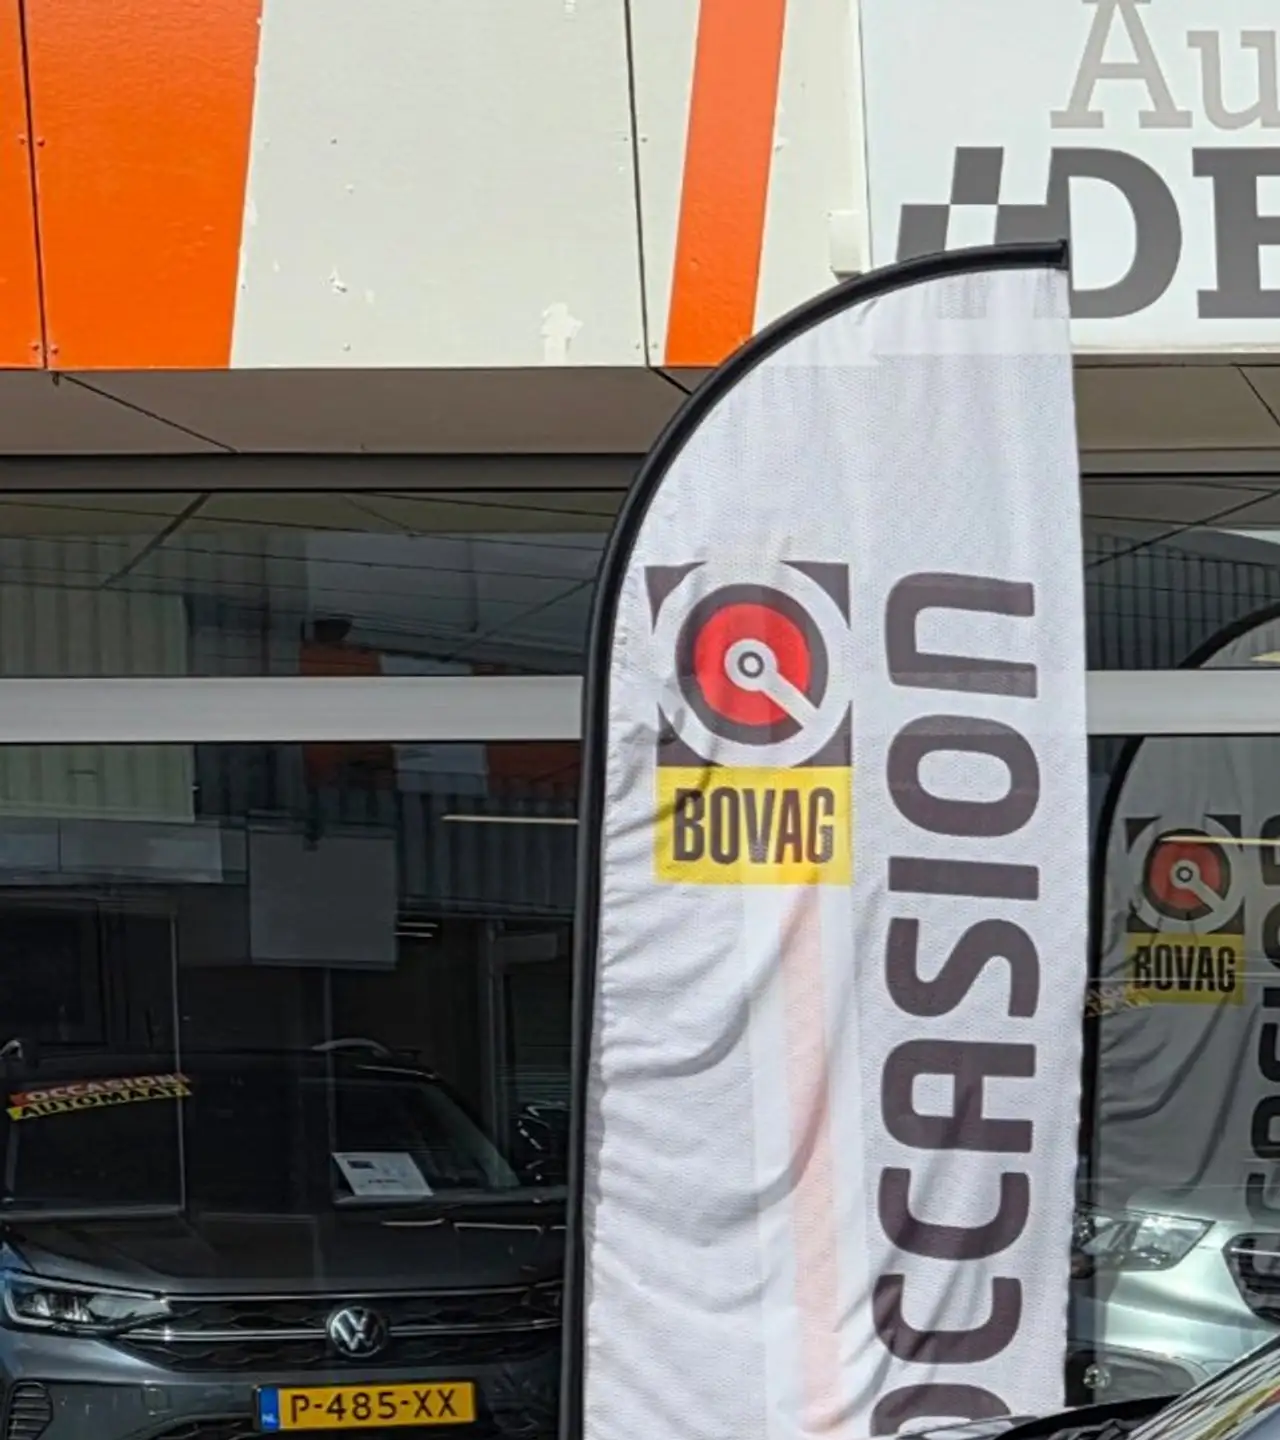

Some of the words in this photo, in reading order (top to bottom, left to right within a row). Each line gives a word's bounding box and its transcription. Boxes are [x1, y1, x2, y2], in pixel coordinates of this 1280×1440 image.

[673, 786, 835, 865] BOVAG
[1131, 944, 1236, 993] BOVAG
[291, 1388, 457, 1424] P-485-XX
